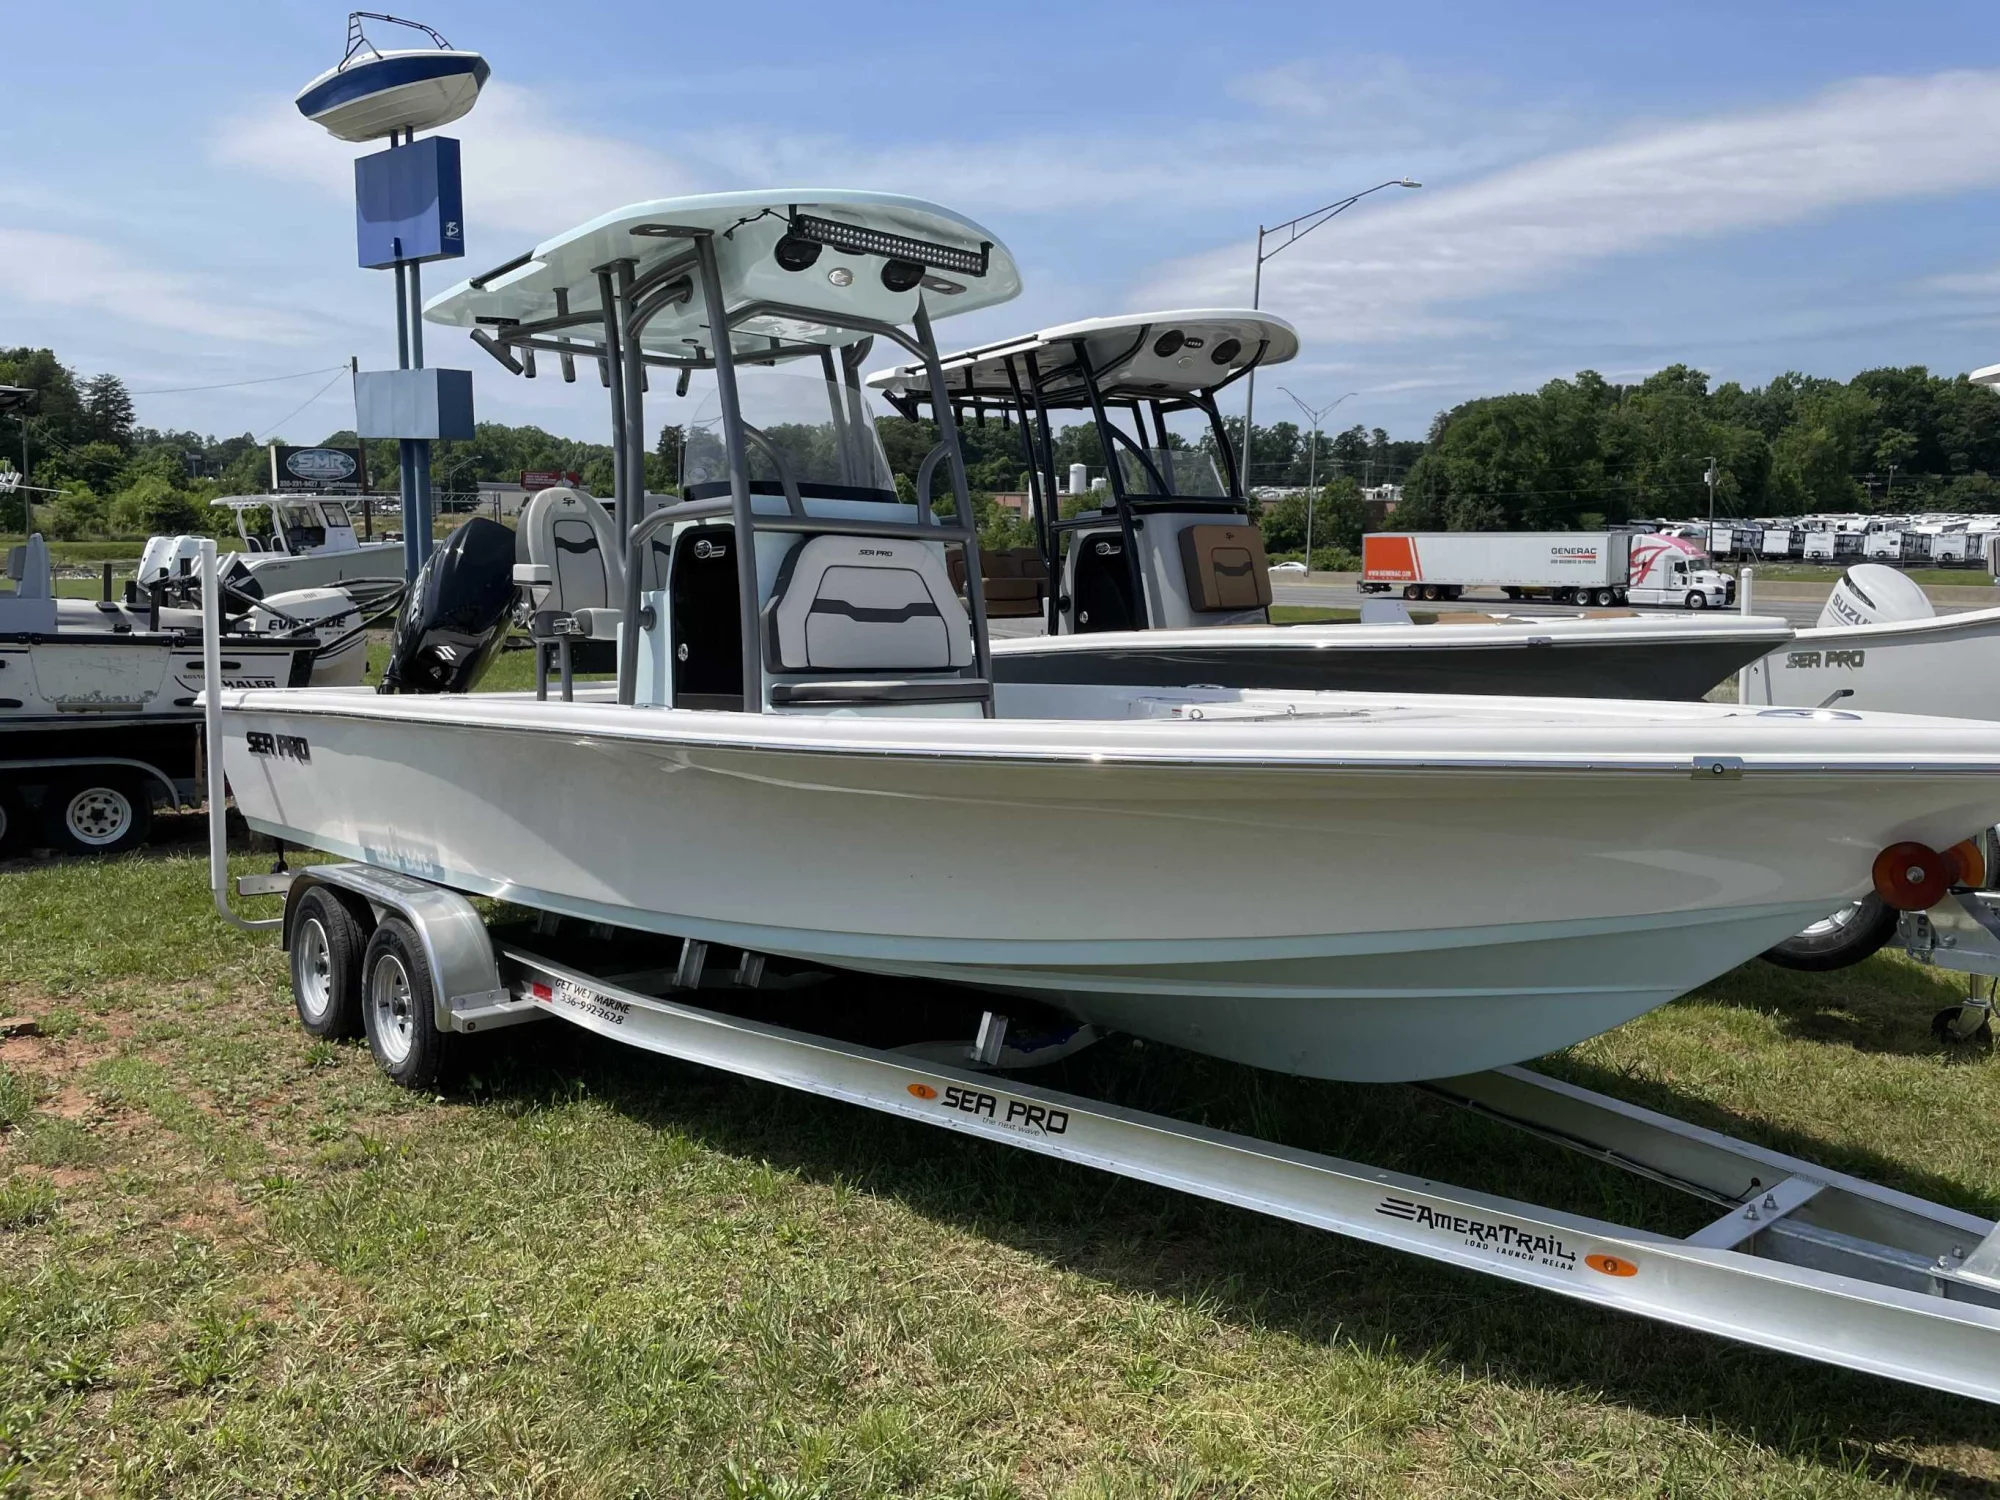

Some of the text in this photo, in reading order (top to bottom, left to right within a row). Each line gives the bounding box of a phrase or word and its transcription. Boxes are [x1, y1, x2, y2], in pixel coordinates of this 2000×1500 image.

[297, 452, 346, 471] SMR
[1551, 547, 1597, 555] GENERAC
[1832, 593, 1873, 625] SUZU
[1786, 650, 1865, 671] SEA PRO
[221, 680, 277, 688] HALER
[246, 731, 311, 767] SEA PRO
[555, 978, 632, 1015] GET WET MARINE
[560, 992, 625, 1025] 336-992-2628
[941, 1086, 1069, 1137] SEA PRO
[982, 1116, 1040, 1137] the next wave
[1465, 1238, 1574, 1271] LOAD LAUNCH RELAX
